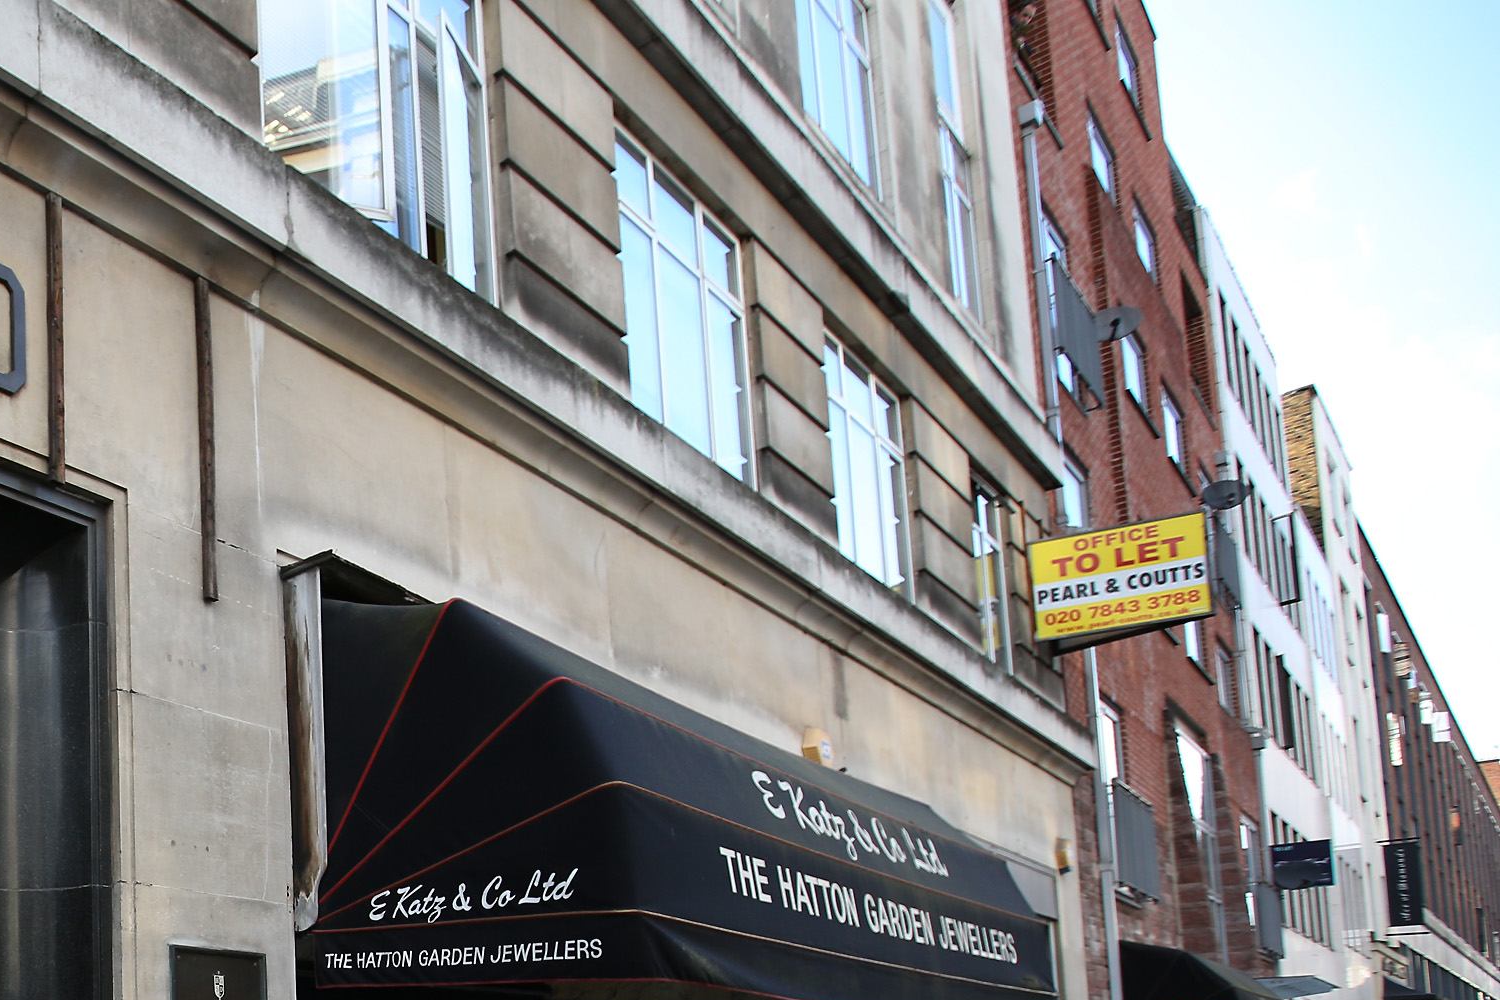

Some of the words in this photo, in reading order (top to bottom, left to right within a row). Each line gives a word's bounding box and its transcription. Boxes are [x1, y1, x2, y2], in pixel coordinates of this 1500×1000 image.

[1051, 552, 1100, 578] TO
[1114, 535, 1186, 568] LET
[1073, 524, 1160, 552] OFFICE
[1037, 581, 1099, 605] PEARL
[1104, 578, 1120, 594] &
[1127, 562, 1206, 590] COUTTS
[1044, 609, 1082, 627] 020
[1087, 599, 1141, 620] 7843
[1146, 589, 1202, 611] 3788
[751, 770, 787, 820] E
[369, 889, 391, 921] E
[392, 884, 448, 923] Katz
[452, 882, 472, 912] &
[481, 875, 516, 910] Co
[518, 867, 579, 905] Ltd
[719, 846, 773, 903] THE
[776, 864, 861, 928] HATTON
[863, 893, 936, 947] GARDEN
[938, 915, 1018, 965] JEWELLERS
[325, 953, 353, 969] THE
[357, 950, 412, 969] HATTON
[418, 947, 486, 967] GARDEN
[490, 938, 603, 964] JEWELLERS
